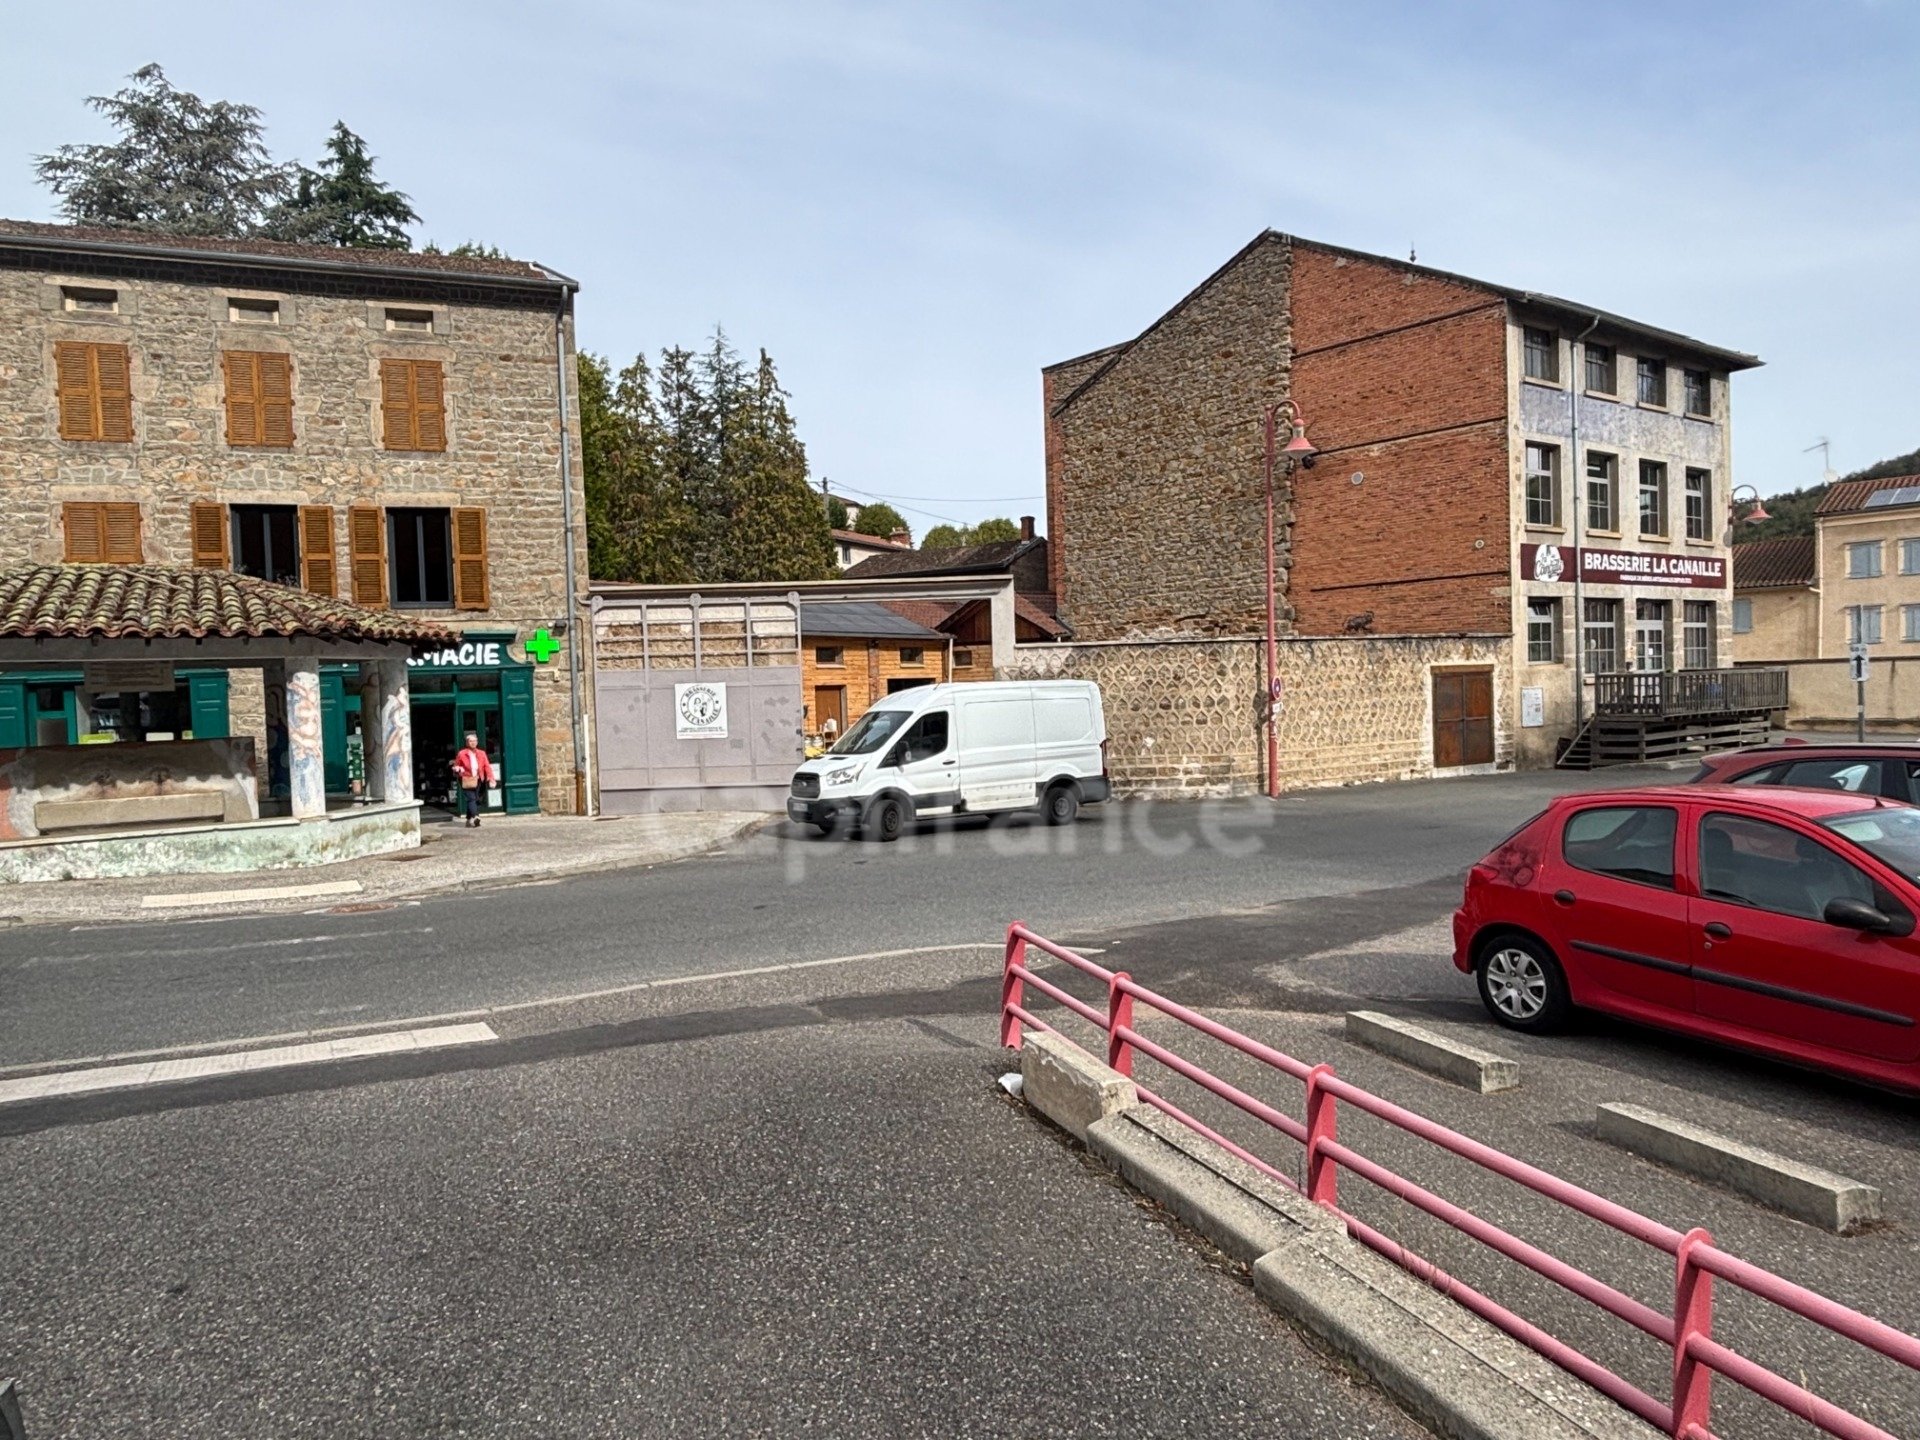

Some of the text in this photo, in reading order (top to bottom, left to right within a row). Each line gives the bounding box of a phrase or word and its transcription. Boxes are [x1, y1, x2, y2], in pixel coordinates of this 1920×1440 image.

[1584, 552, 1722, 577] BRASSERIE LA CANAILLE
